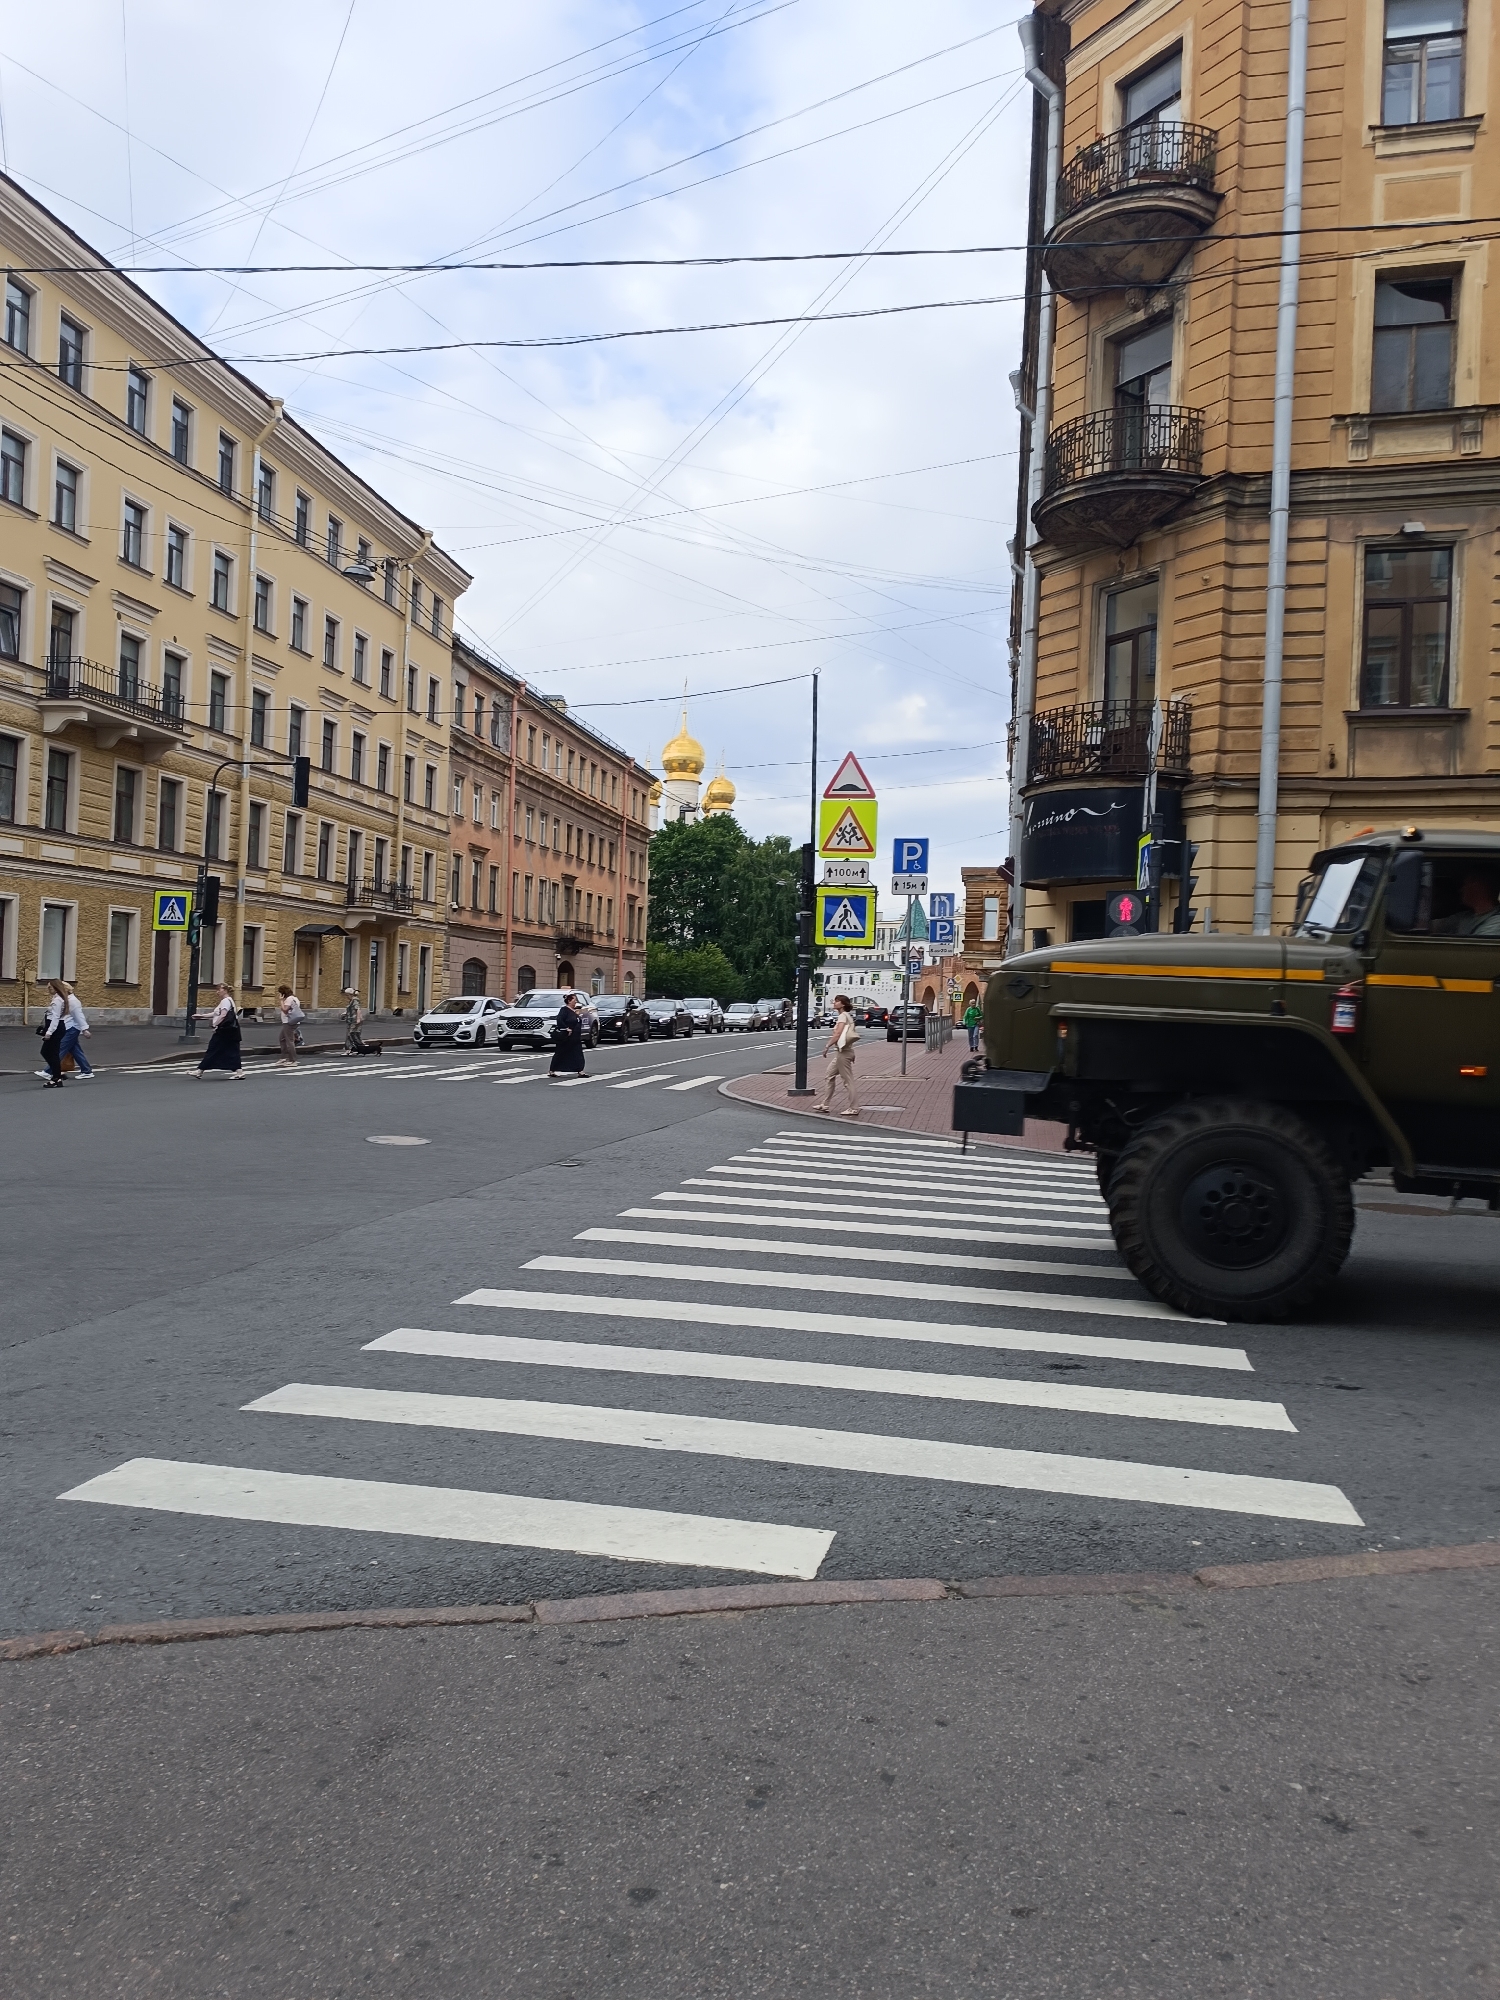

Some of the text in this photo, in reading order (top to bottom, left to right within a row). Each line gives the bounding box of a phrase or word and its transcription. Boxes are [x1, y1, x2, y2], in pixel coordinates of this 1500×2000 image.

[902, 842, 922, 870] P
[834, 868, 859, 877] 100м
[902, 881, 917, 890] 15м
[936, 921, 951, 940] P
